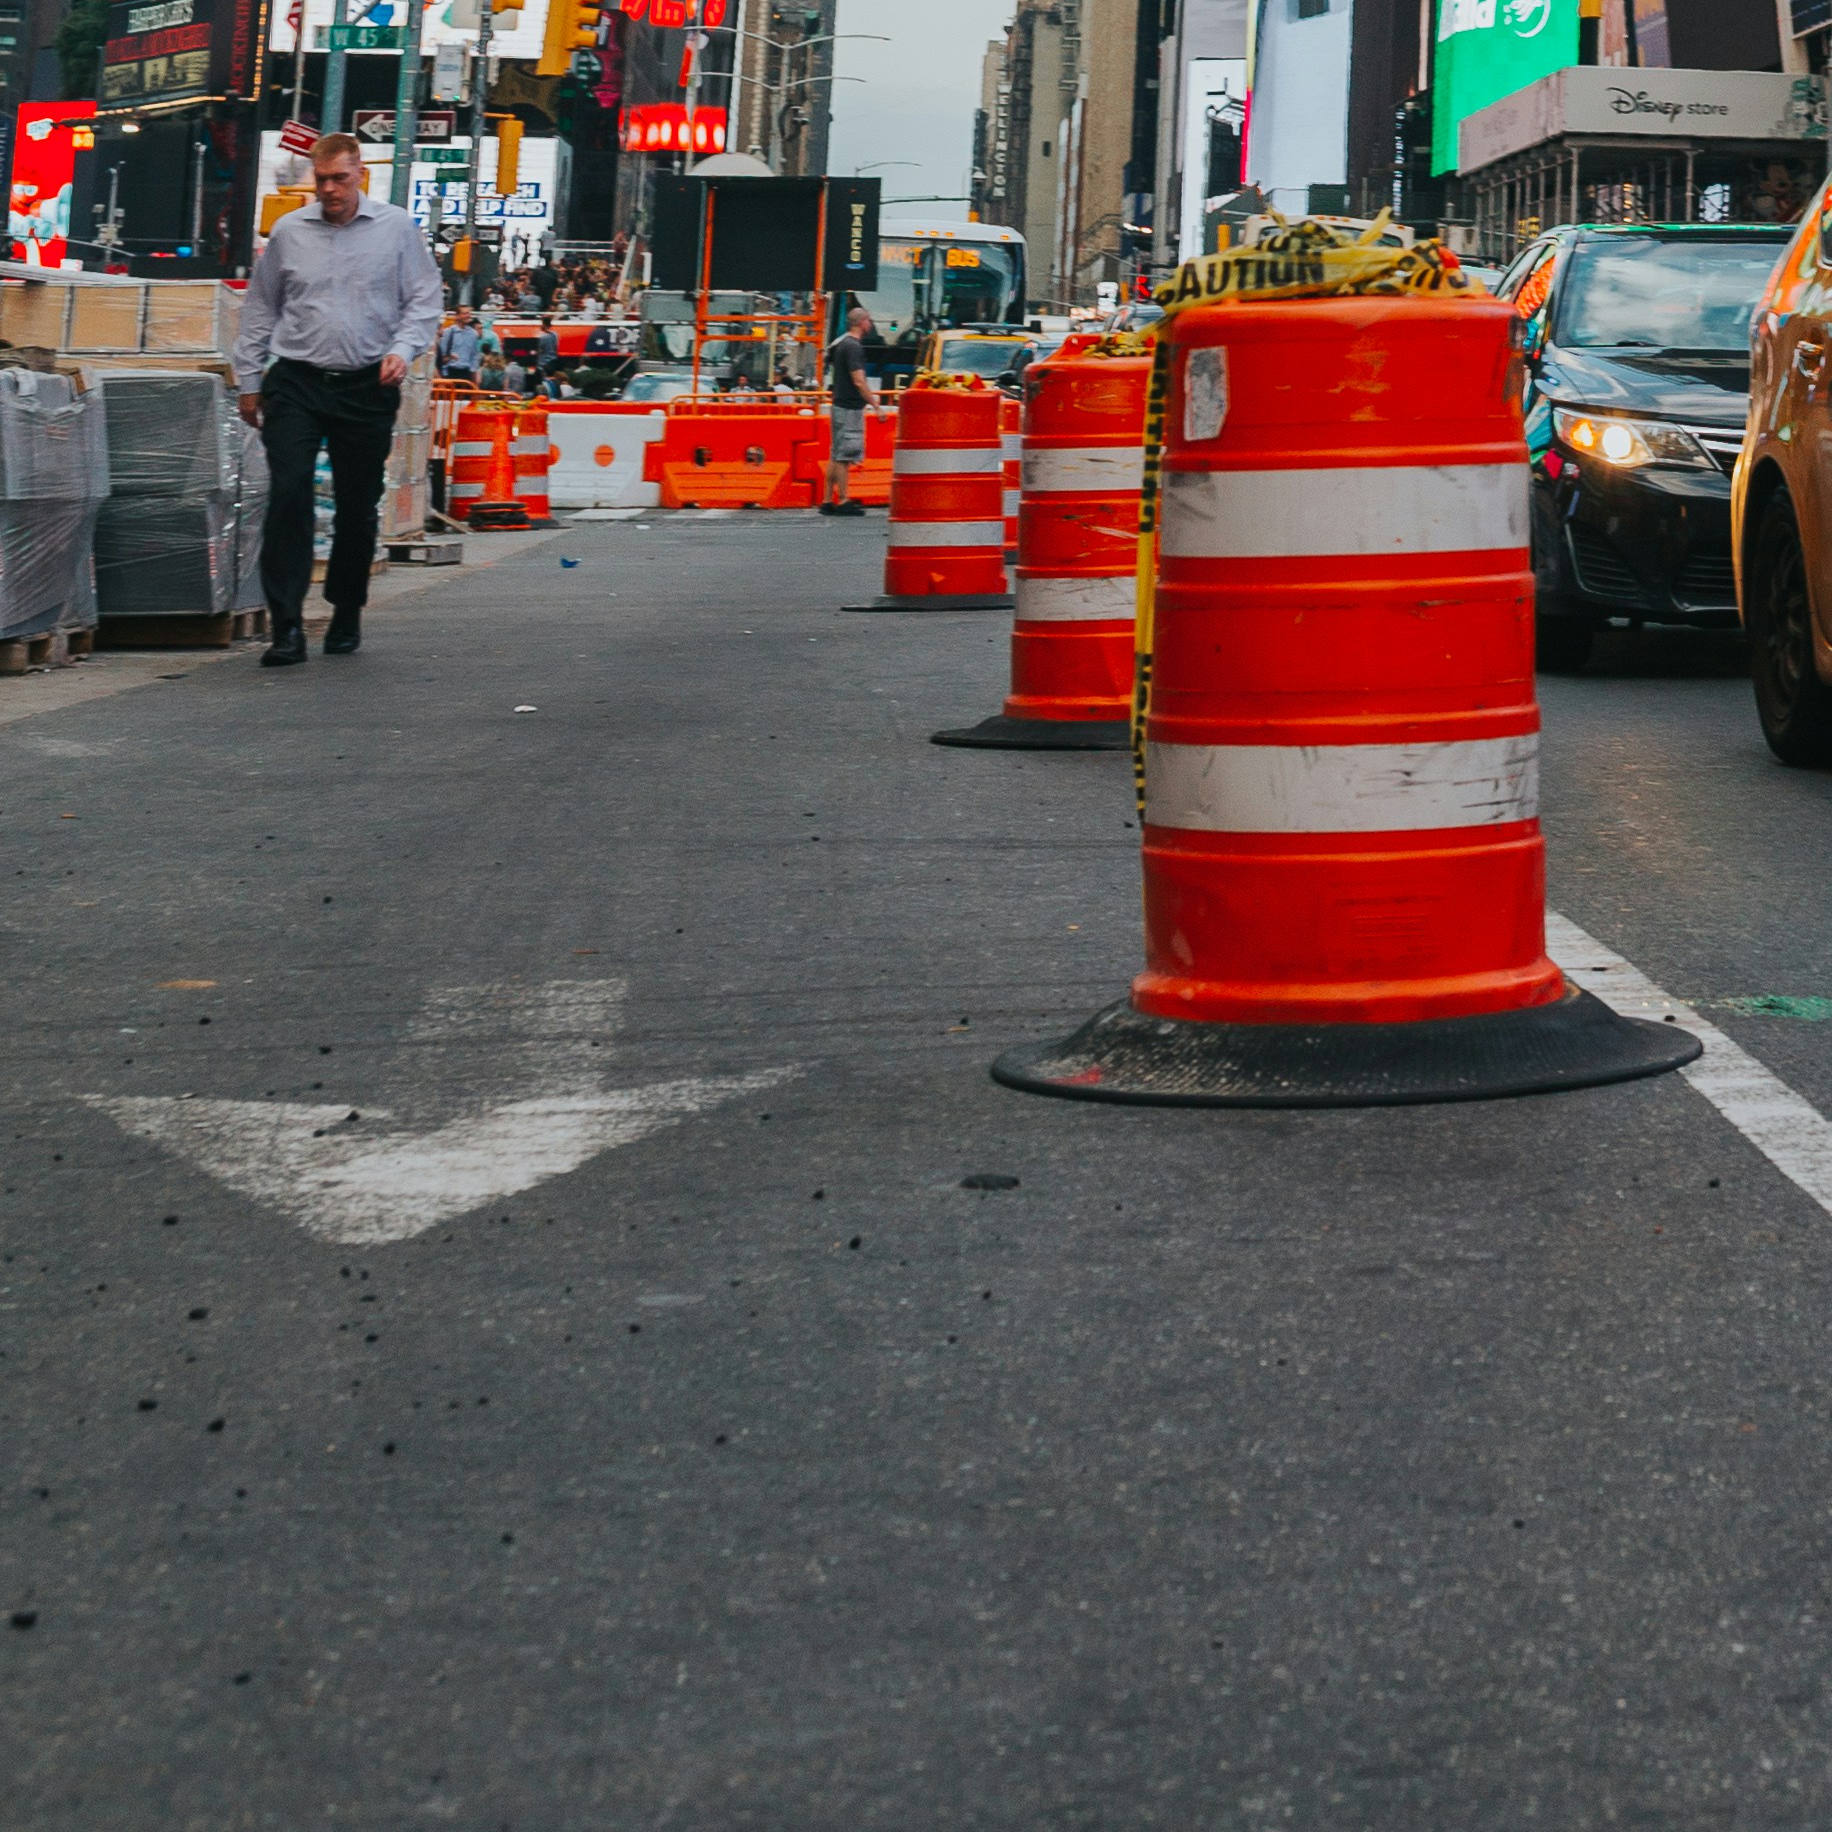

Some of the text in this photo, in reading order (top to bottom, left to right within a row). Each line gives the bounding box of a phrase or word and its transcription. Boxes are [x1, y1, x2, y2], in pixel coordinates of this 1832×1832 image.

[333, 28, 350, 47] W
[356, 27, 379, 48] 45
[1686, 103, 1729, 116] store
[416, 201, 457, 214] AD
